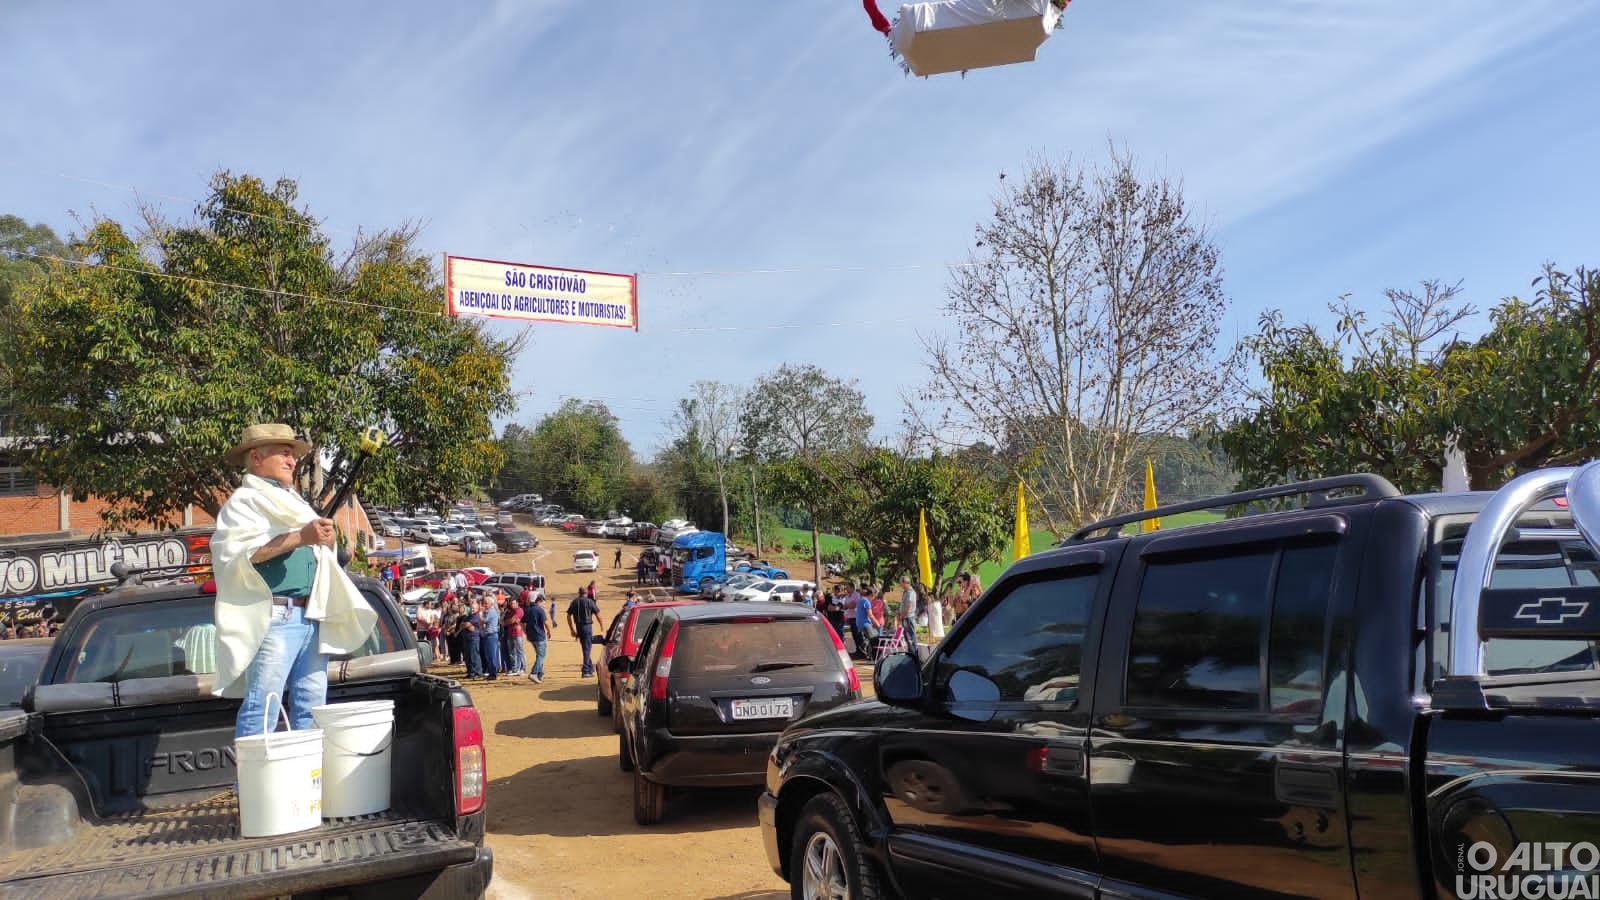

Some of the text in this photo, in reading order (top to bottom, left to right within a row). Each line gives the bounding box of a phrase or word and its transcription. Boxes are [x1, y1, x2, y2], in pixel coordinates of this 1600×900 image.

[505, 267, 586, 294] SÃO CRISTÓVÃO
[459, 290, 499, 313] ABENÇOAI
[501, 298, 512, 311] OS
[514, 295, 570, 316] AGRICULTORES
[578, 302, 626, 320] MOTORISTAS!
[41, 539, 187, 590] MILÊNIO
